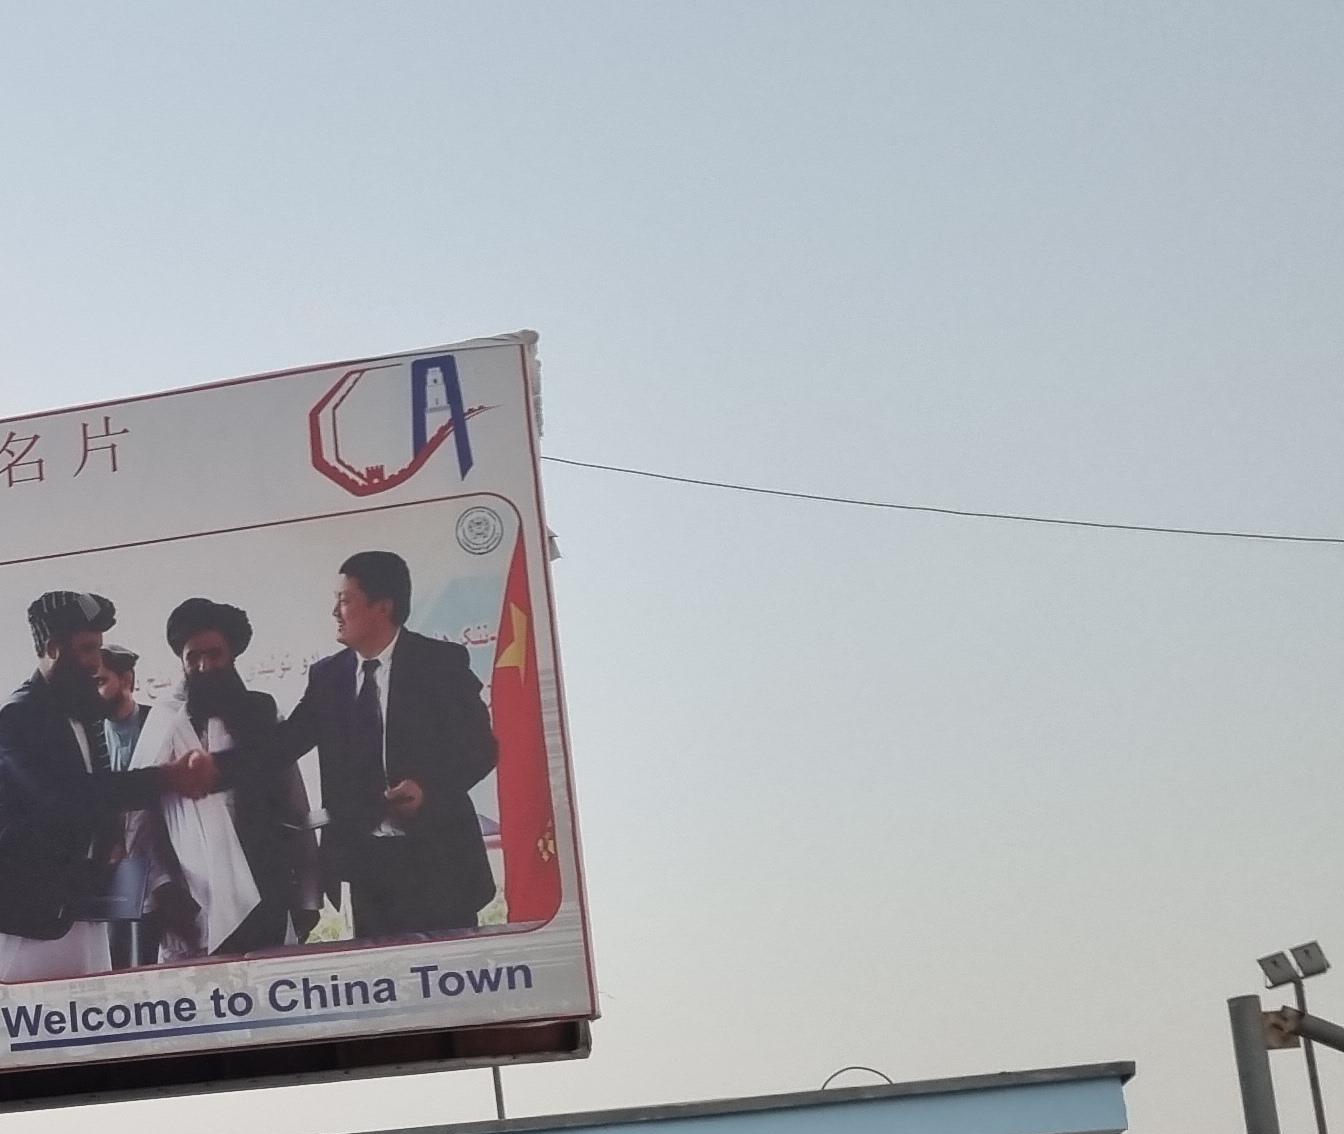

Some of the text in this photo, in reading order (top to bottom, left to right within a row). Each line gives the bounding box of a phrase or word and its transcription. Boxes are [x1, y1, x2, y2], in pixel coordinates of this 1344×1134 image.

[1, 960, 534, 1039] Welcome to China Town
